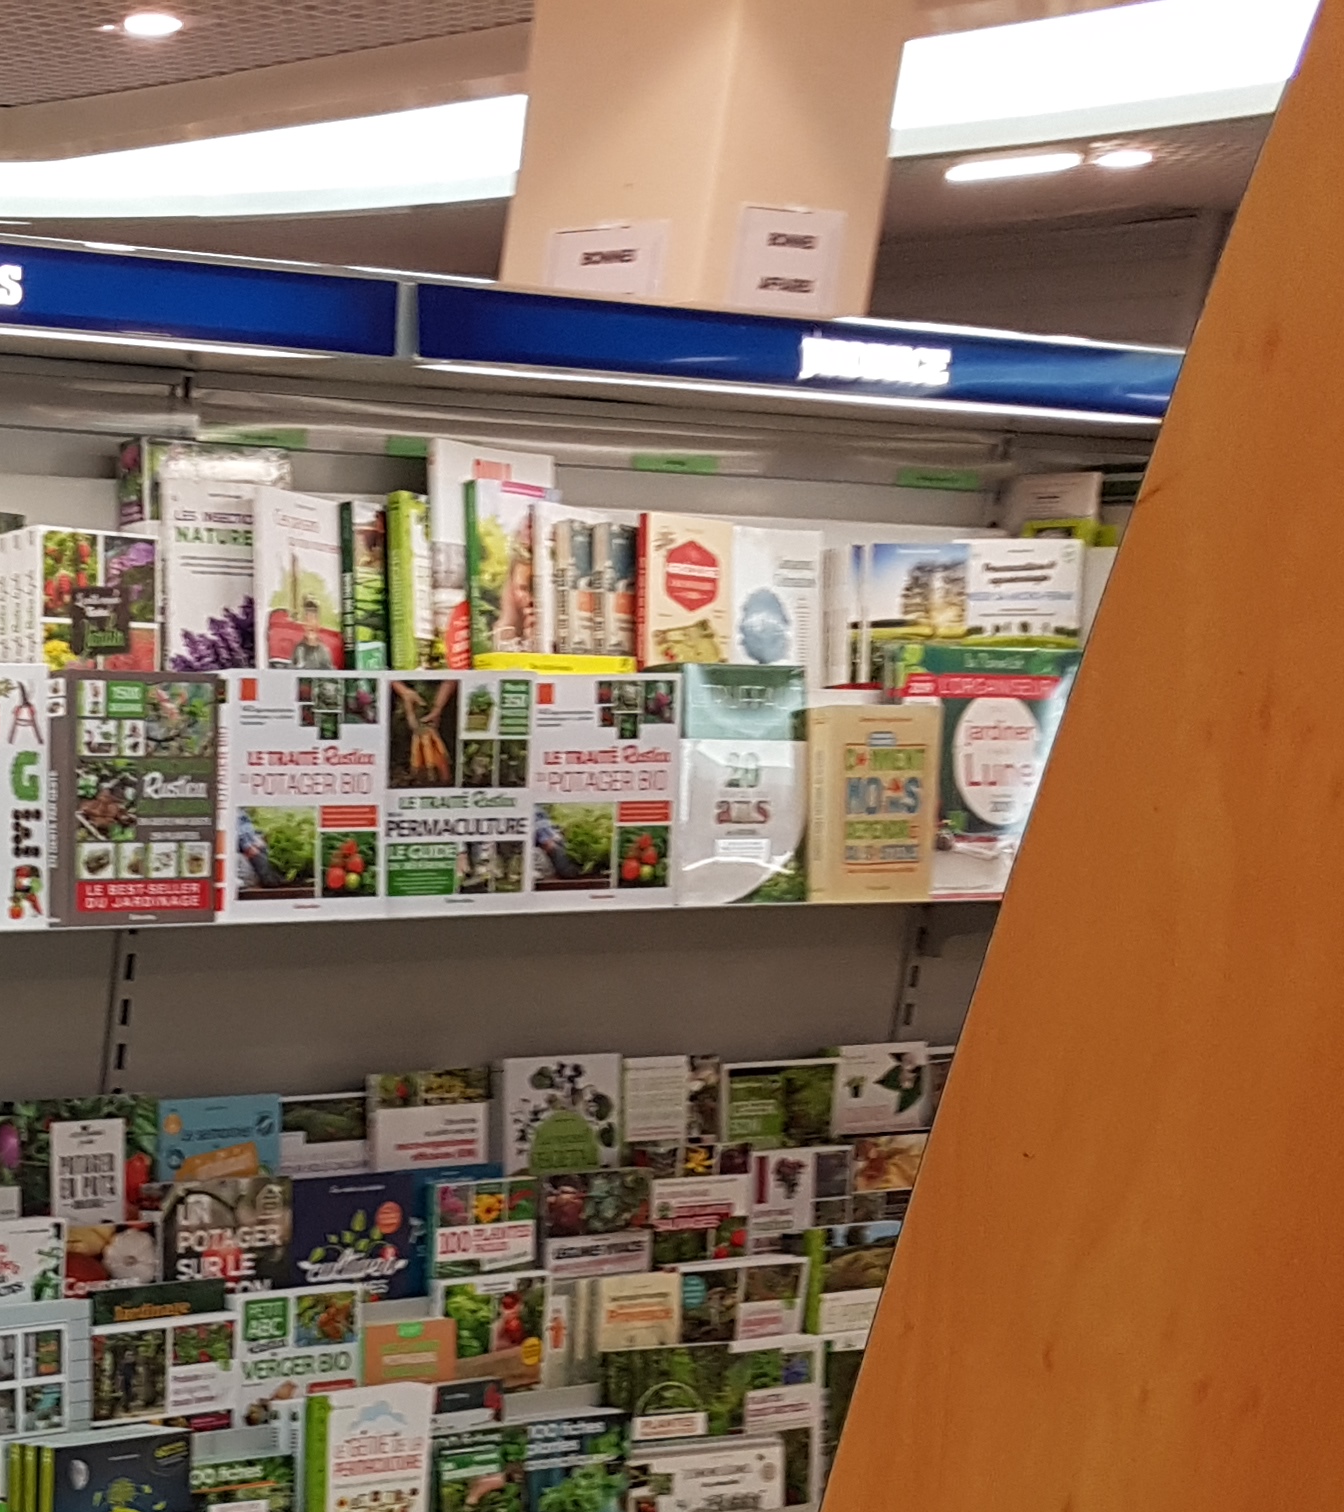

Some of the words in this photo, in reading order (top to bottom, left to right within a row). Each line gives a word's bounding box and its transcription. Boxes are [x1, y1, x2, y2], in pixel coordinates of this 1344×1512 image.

[246, 752, 266, 766] LE
[268, 748, 320, 766] TRAITÉ
[543, 751, 563, 765] LE
[249, 773, 337, 795] POTAGER
[341, 773, 373, 795] BIO
[547, 770, 633, 793] POTAGER
[637, 769, 669, 792] BIO
[398, 797, 416, 810] LE
[385, 817, 529, 838] PERMACULTURE
[85, 883, 105, 897] LE
[107, 881, 201, 897] BEST-SELLER
[84, 896, 107, 909] DU
[111, 894, 200, 909] JARDINAGE
[176, 1225, 282, 1254] POTAGER
[439, 1231, 473, 1255] 100
[176, 1256, 223, 1282] SUR
[226, 1254, 256, 1277] LE
[246, 1317, 285, 1337] ABC
[241, 1357, 315, 1381] VERGER
[317, 1350, 352, 1373] BIO
